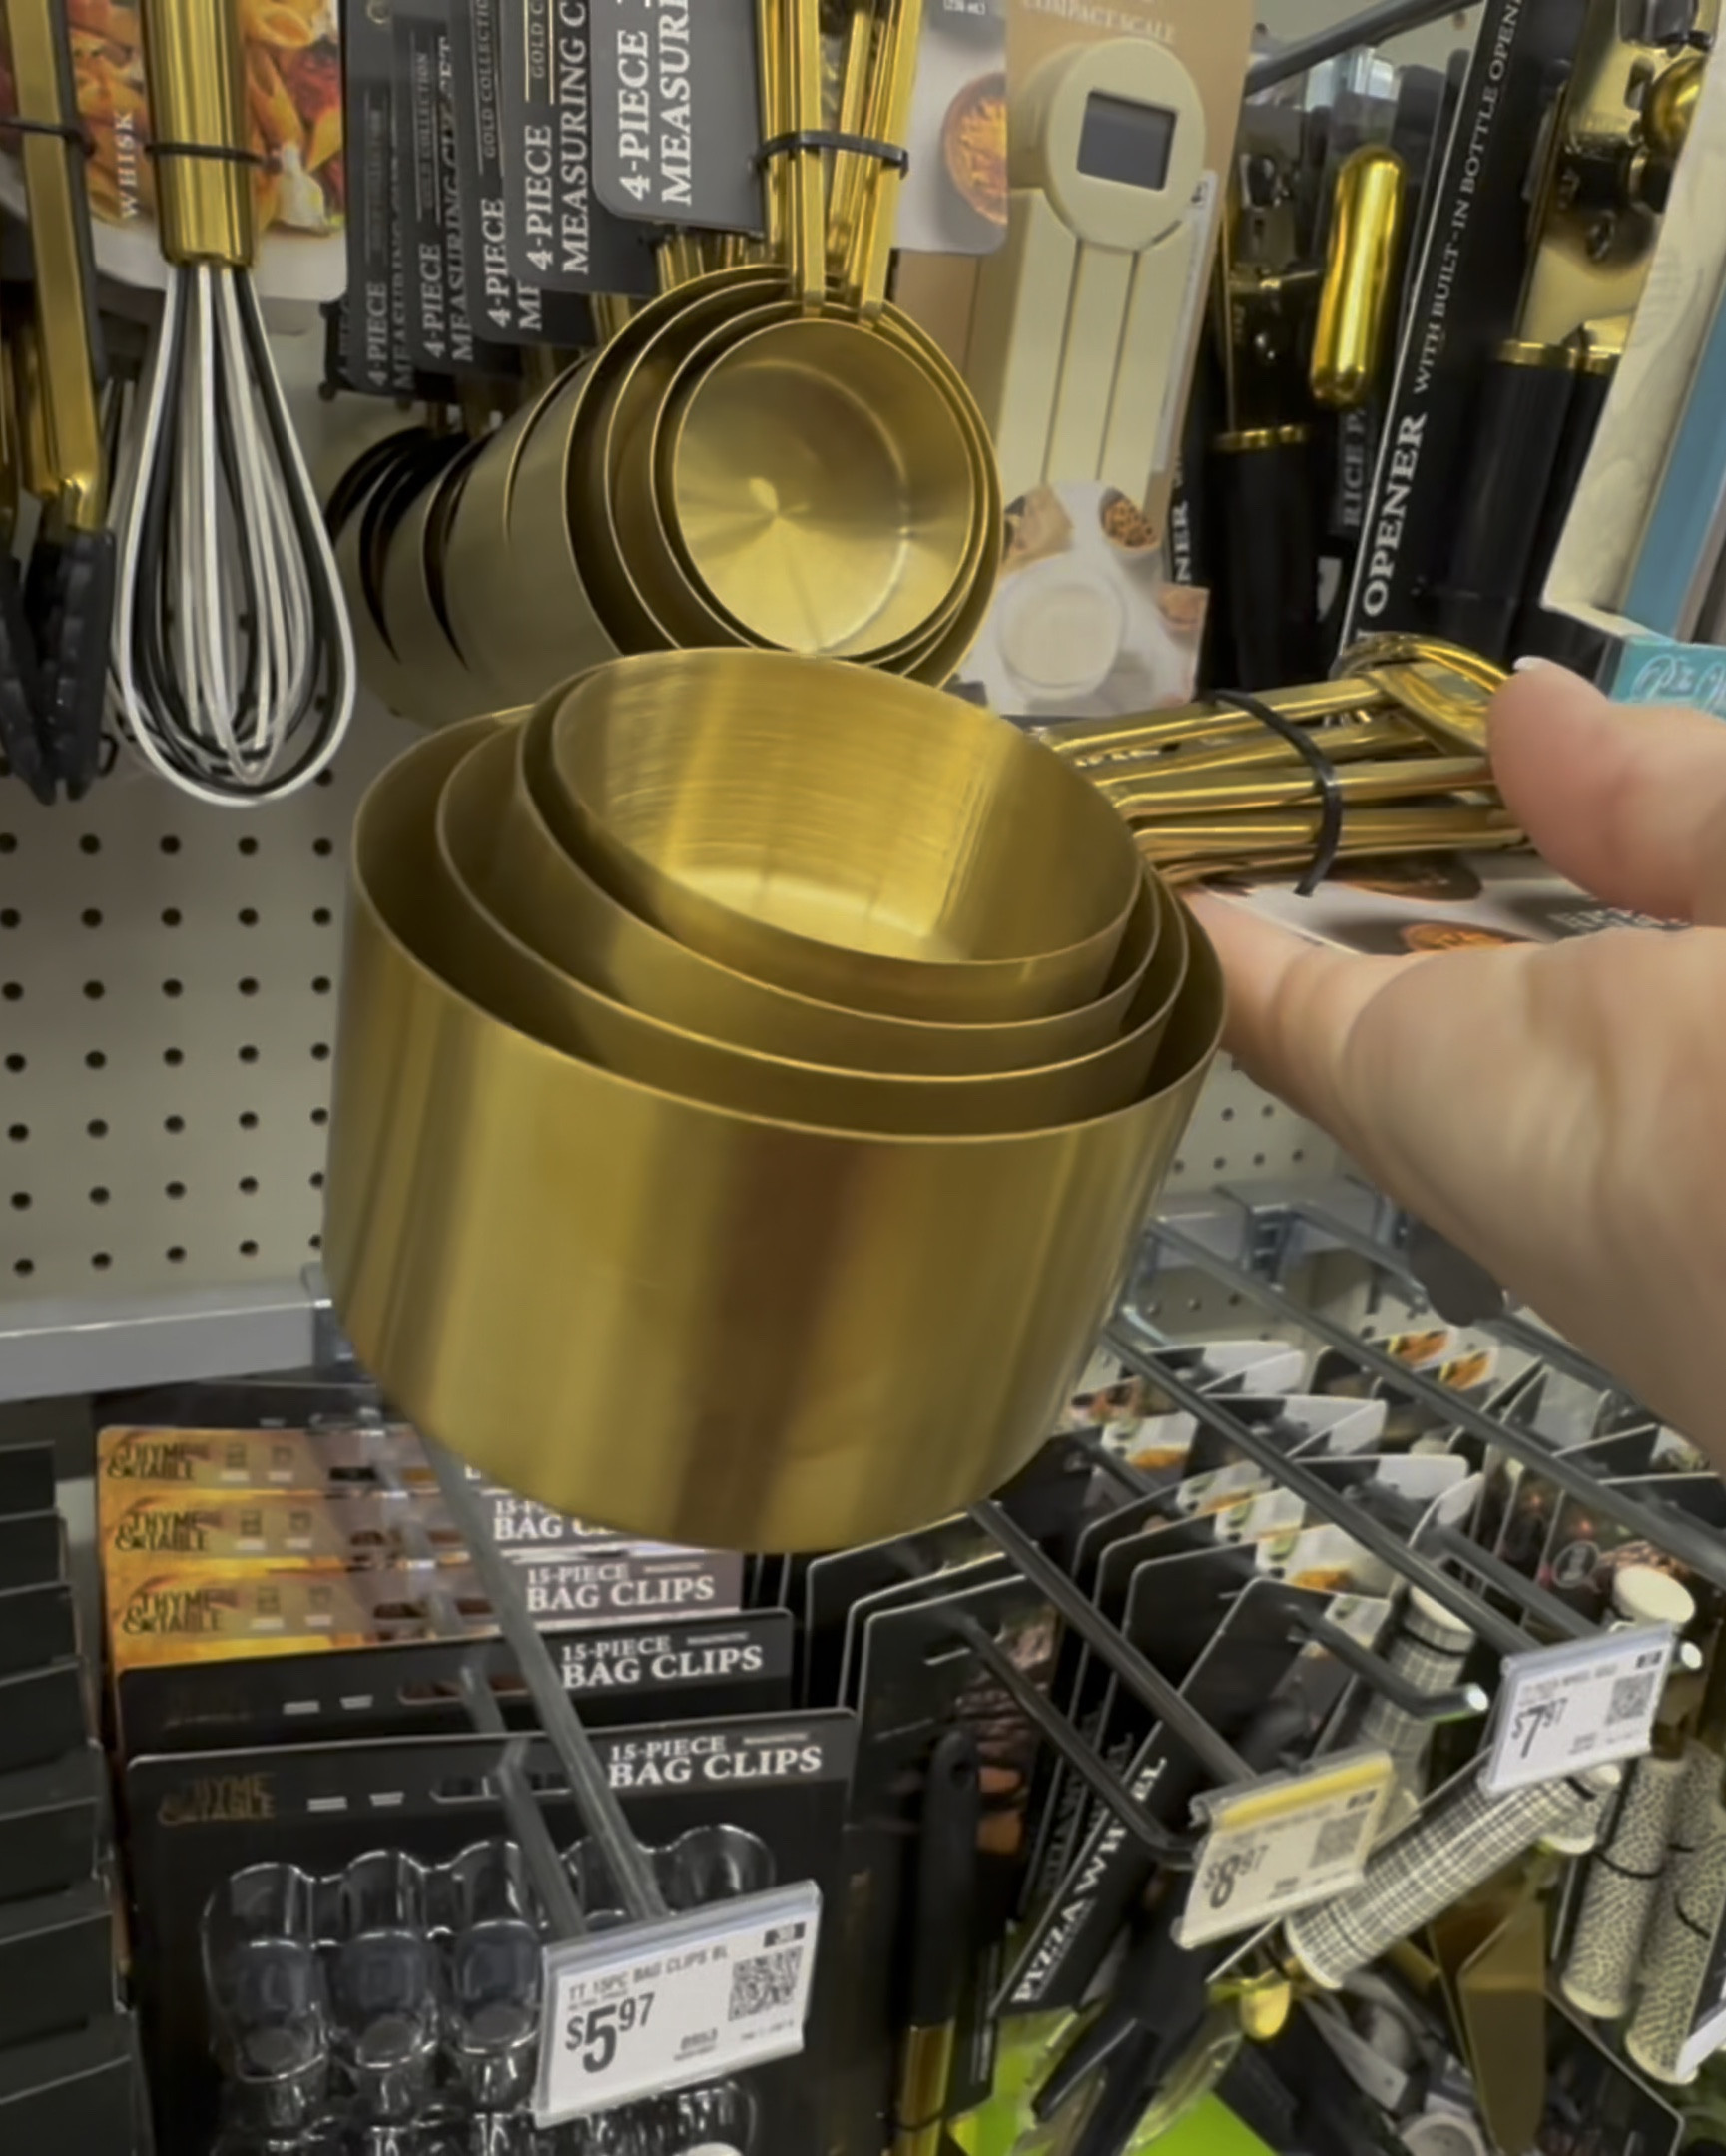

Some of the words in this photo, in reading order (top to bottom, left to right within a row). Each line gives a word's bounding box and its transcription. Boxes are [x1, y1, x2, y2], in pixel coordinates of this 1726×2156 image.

[530, 22, 546, 79] GOLD
[616, 29, 651, 201] 4-PIECE
[112, 110, 139, 219] WHISK
[559, 38, 590, 275] MEASURING
[524, 125, 554, 271] 4-PIECE
[418, 243, 446, 359] 4-PIECE
[481, 198, 512, 328] 4-PIECE
[366, 281, 388, 387] 4-PIECE
[1363, 412, 1428, 617] OPENER
[1413, 321, 1442, 395] WITH
[1459, 87, 1498, 196] BOTTLE
[1489, 0, 1522, 81] OPEN
[494, 1515, 563, 1541] BAG
[526, 1584, 600, 1613] BAG
[611, 1575, 715, 1607] CLIPS
[527, 1563, 629, 1585] 15-PIECE
[562, 1635, 671, 1662] 15-PIECE
[562, 1658, 641, 1689] BAG
[652, 1645, 763, 1680] CLIPS
[610, 1735, 727, 1761] 15-PIECE
[610, 1758, 692, 1788] BAG
[704, 1746, 823, 1780] CLIPS
[569, 1981, 587, 2003] TT
[633, 1961, 662, 1984] BAG
[665, 1949, 707, 1974] CLIPS
[1010, 1899, 1086, 2002] PIZZA
